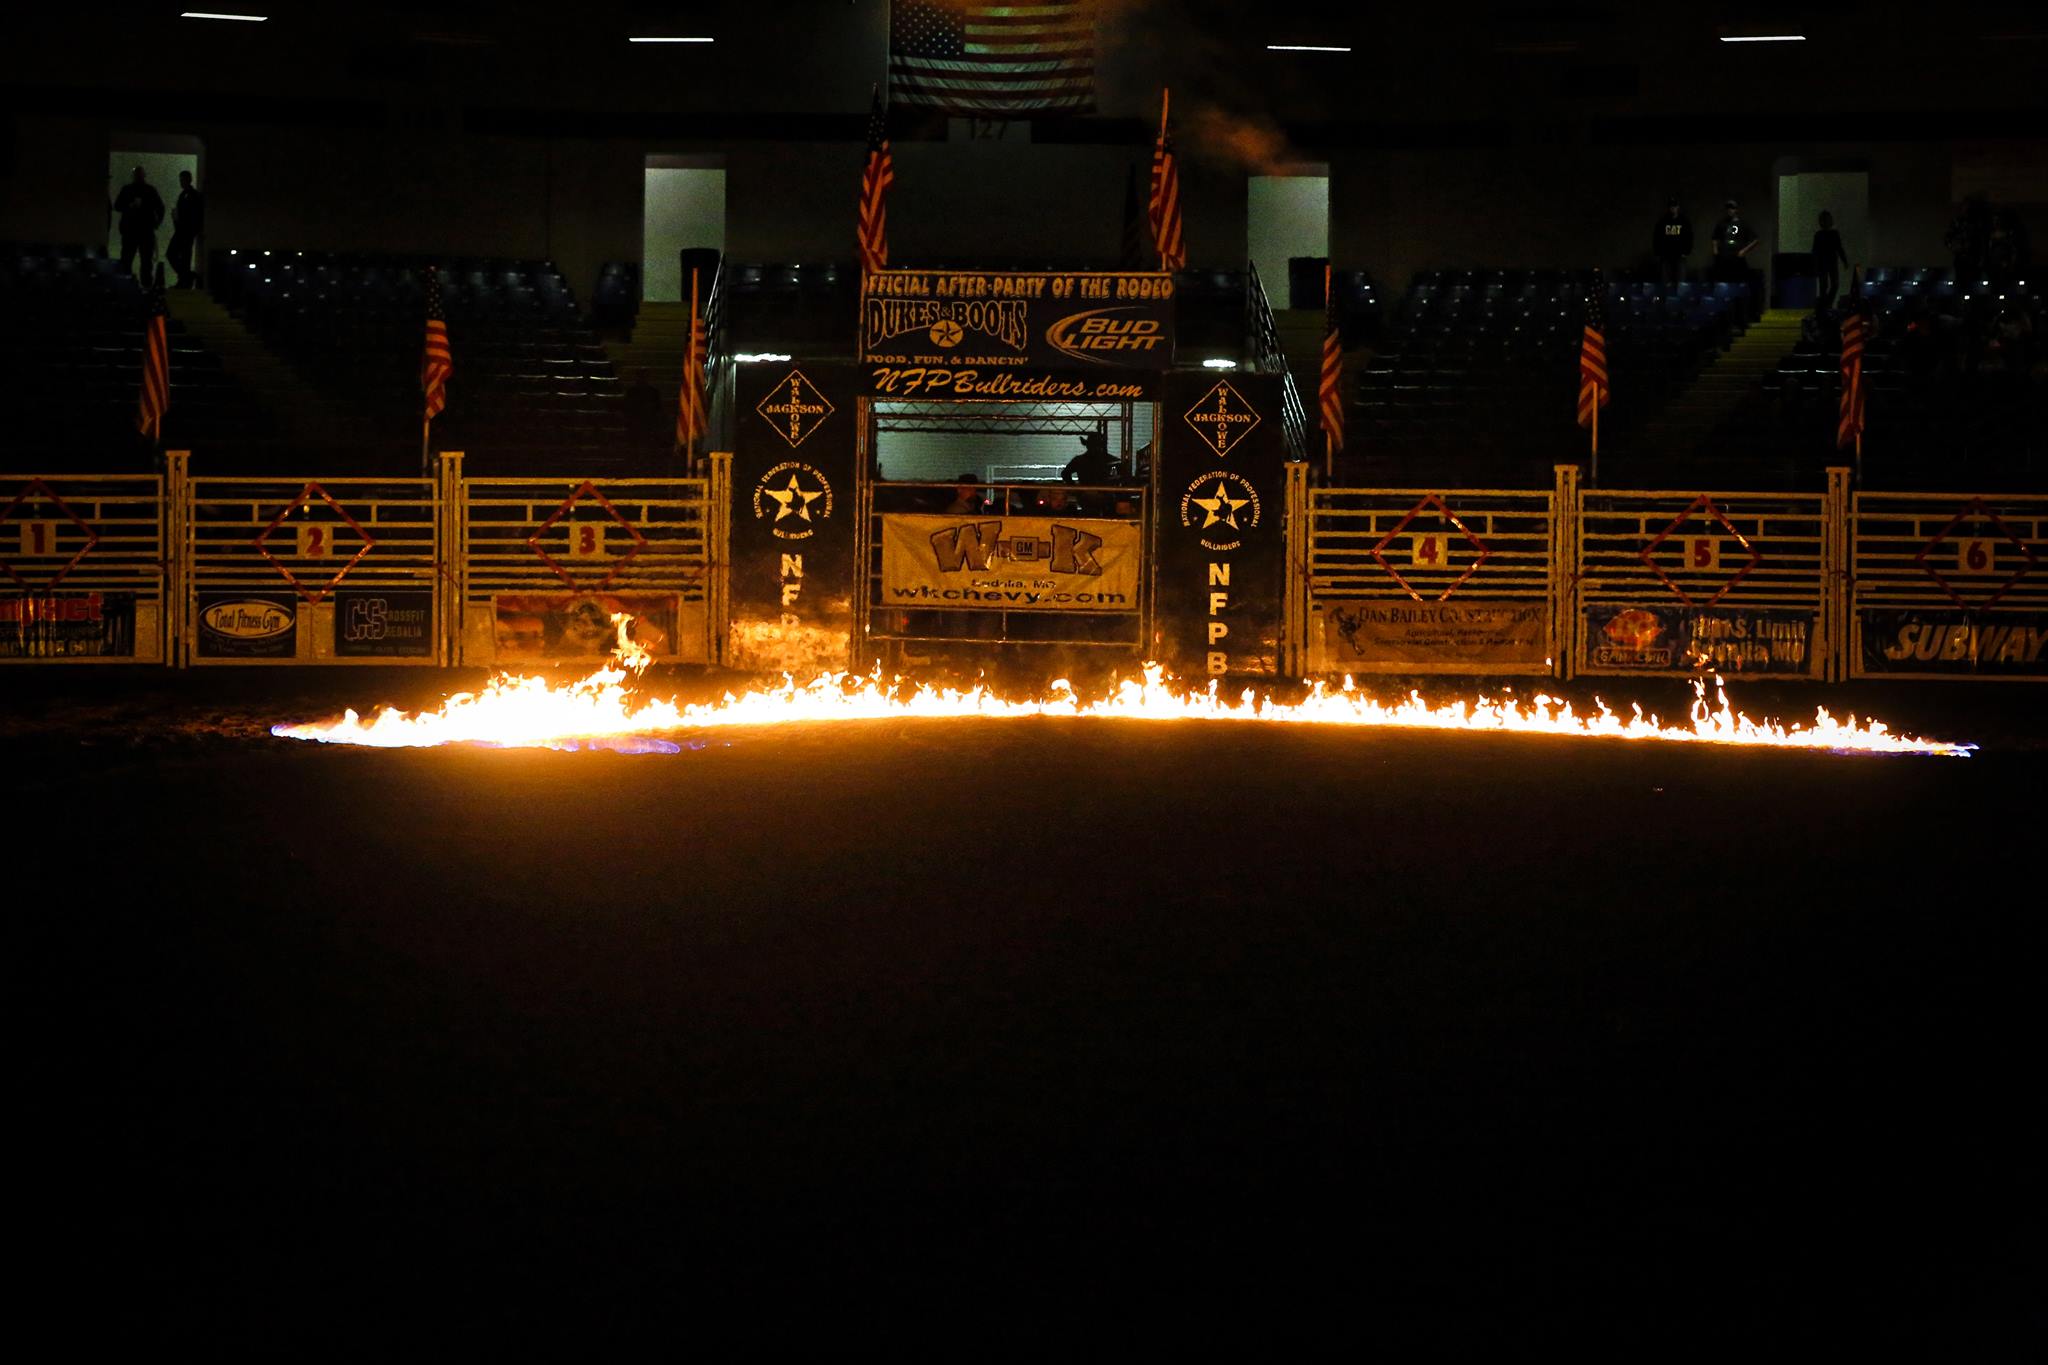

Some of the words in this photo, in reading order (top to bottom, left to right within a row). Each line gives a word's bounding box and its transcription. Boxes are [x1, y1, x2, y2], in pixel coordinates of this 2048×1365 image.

[1665, 224, 1682, 236] CAT
[862, 275, 930, 297] FFICIAL
[1051, 277, 1075, 299] OF
[1079, 277, 1111, 299] THE
[1116, 278, 1174, 300] RODEO
[867, 298, 941, 350] DUKES
[951, 300, 1028, 351] BOOTS
[1080, 317, 1160, 334] BUD
[1060, 333, 1166, 350] LIGHT
[950, 355, 962, 365] &
[872, 367, 1144, 398] NFPBullriders.com
[766, 404, 824, 414] JACKSON
[1193, 413, 1251, 423] JACKSON
[1187, 470, 1228, 491] FEDERATION
[1229, 472, 1240, 481] OF
[1240, 478, 1262, 528] PROFESSIONAL
[31, 523, 44, 554] 1
[306, 527, 325, 557] 2
[579, 526, 596, 554] 3
[930, 520, 1002, 573] W
[1016, 541, 1033, 555] GM
[1050, 524, 1102, 576] K
[1419, 537, 1439, 565] 4
[1694, 540, 1711, 567] 5
[1967, 541, 1987, 570] 6
[892, 585, 1127, 604] wkchevy.com
[262, 607, 281, 633] Gym
[1207, 562, 1231, 675] NFPB
[1359, 606, 1387, 624] DAN
[1391, 607, 1437, 624] BAILEY
[1756, 619, 1806, 640] Limit
[1884, 624, 2048, 662] SUBWAY
